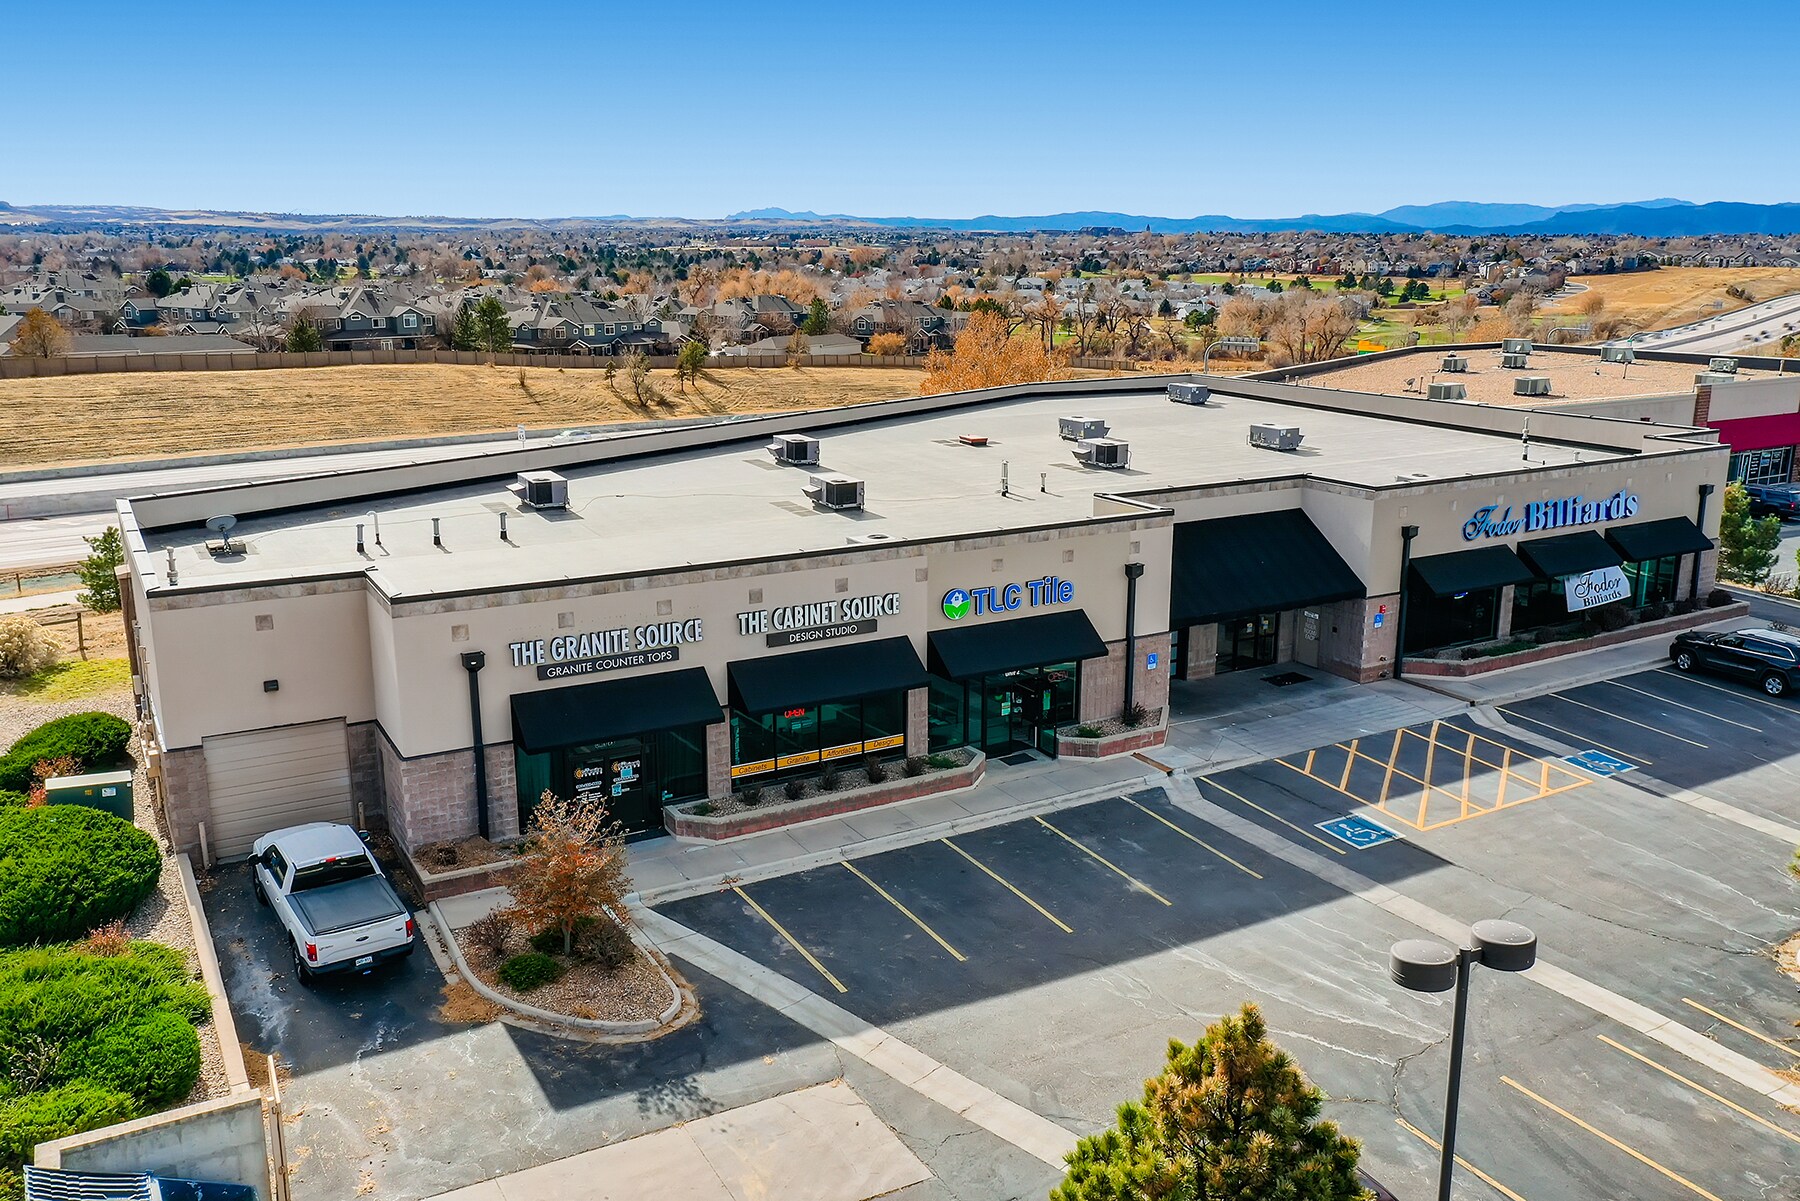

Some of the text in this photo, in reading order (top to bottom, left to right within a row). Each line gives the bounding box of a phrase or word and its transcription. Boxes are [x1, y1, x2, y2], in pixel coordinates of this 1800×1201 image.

[1462, 489, 1639, 541] Fodor Billiards
[971, 576, 1074, 615] TLC Tile
[1574, 572, 1621, 598] Fodor
[1583, 590, 1622, 607] Billiards
[737, 593, 900, 635] THE CABINET SOURCE
[510, 618, 703, 667] THE GRANITE SOURCE
[789, 624, 858, 643] DESIGN STUDIO
[547, 650, 673, 677] GRANITE COUNTER TOPS
[784, 708, 805, 718] OPEN
[738, 738, 895, 774] Cabinets Granite Affordable Design
